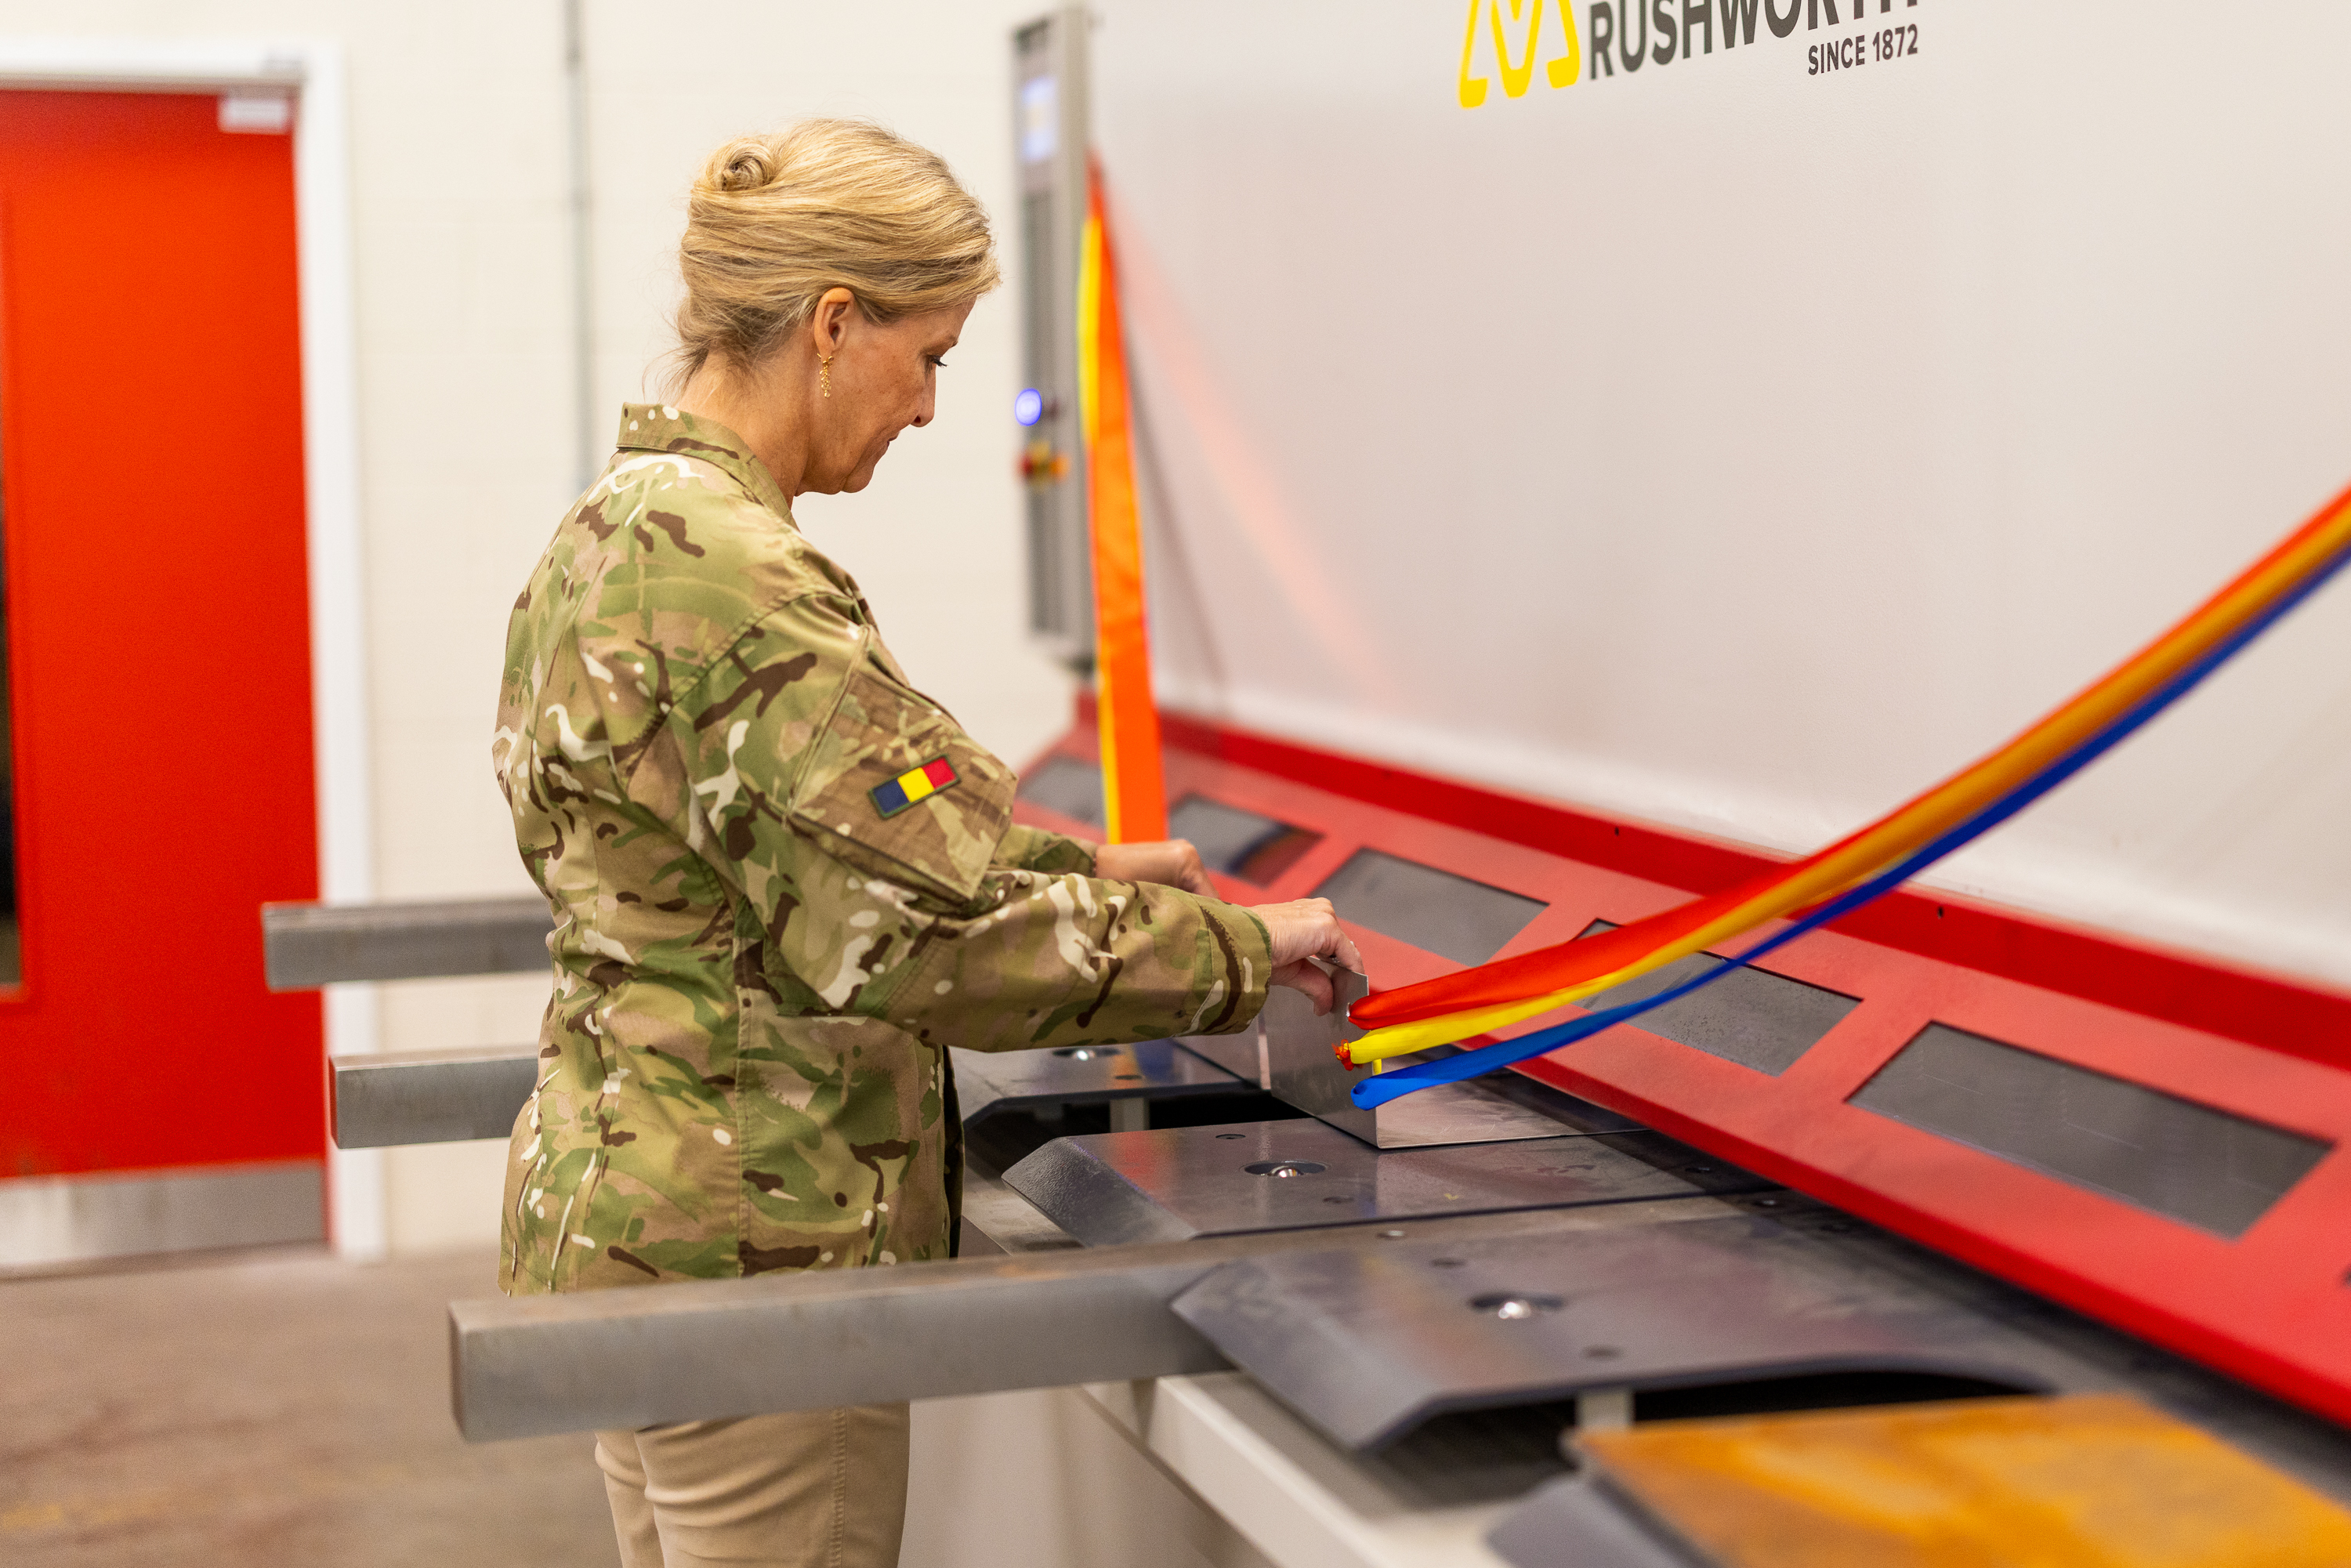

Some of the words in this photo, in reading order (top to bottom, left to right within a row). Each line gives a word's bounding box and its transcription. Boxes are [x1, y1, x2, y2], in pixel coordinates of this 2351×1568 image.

[1590, 0, 1918, 80] RUSHWO
[1808, 35, 1865, 76] SINCE
[1872, 24, 1918, 62] 1872
